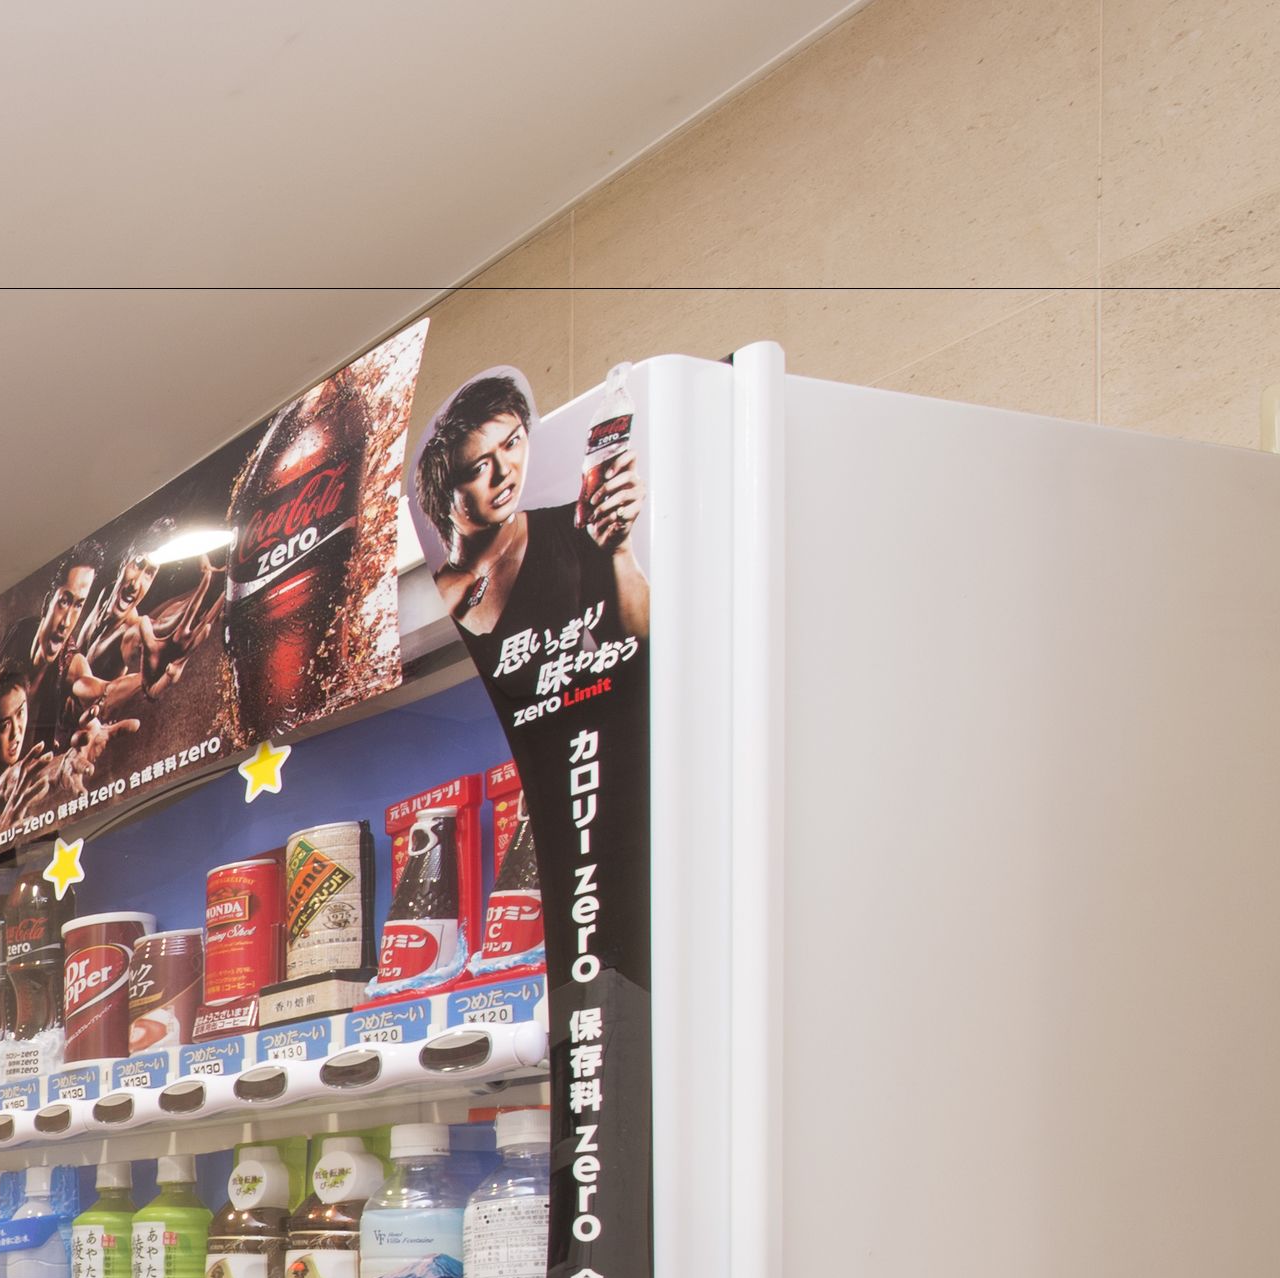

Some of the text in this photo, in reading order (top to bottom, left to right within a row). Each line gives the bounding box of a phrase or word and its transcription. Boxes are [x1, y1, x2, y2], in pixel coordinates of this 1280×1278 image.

[257, 527, 317, 576] zero
[493, 601, 605, 677] 思いっきり
[536, 635, 639, 695] 味わおう
[513, 677, 612, 727] zero Limit
[489, 922, 501, 938] C
[7, 942, 31, 956] zero
[382, 950, 393, 965] C
[66, 958, 90, 979] Dr
[364, 1029, 399, 1042] ¥120
[124, 1075, 148, 1087] ¥130
